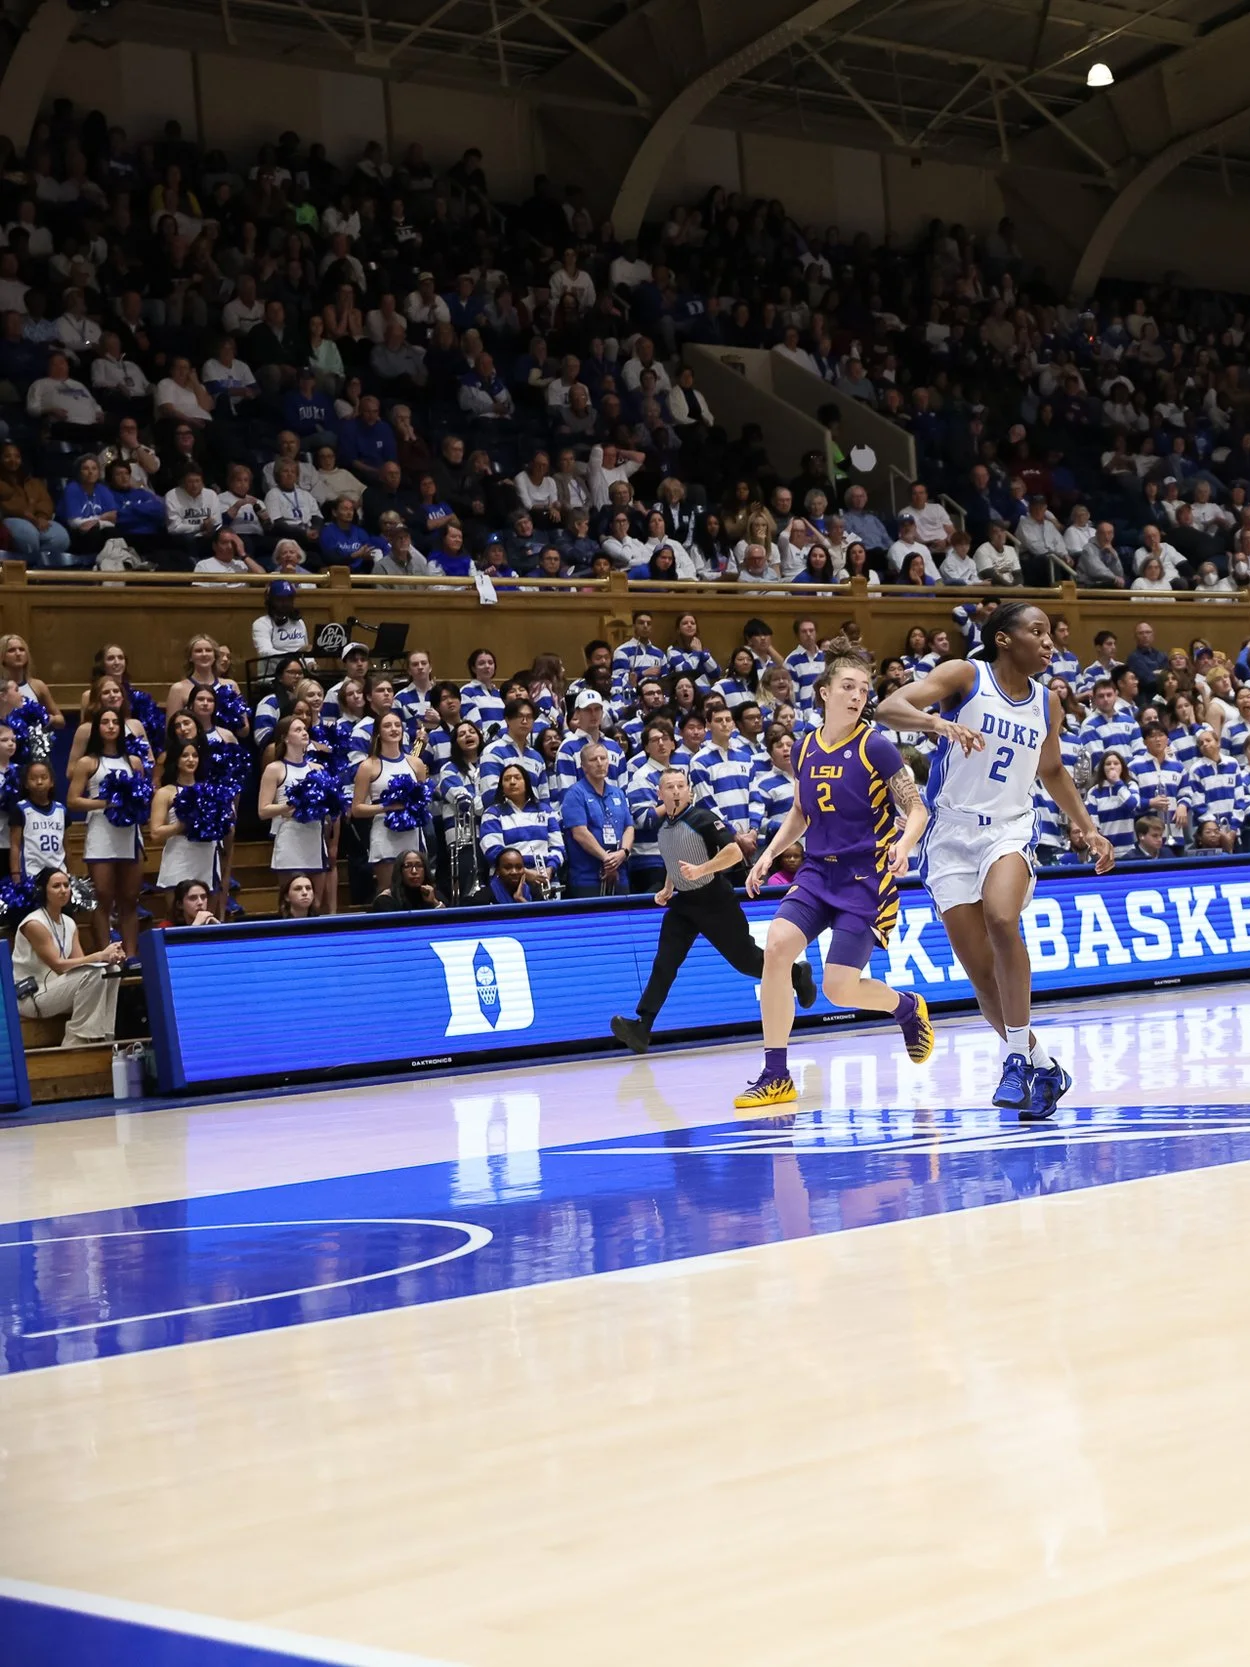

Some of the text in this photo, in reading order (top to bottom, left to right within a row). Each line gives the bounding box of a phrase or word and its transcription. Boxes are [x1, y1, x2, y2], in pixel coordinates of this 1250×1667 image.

[278, 629, 305, 641] Duke
[327, 625, 338, 636] DJ
[981, 713, 1039, 750] DUKE
[989, 746, 1015, 783] 2
[810, 766, 843, 779] LSU
[817, 782, 835, 812] 2
[32, 821, 63, 832] DUKE
[40, 835, 59, 851] 26
[823, 1013, 855, 1022] DAKTRONICS
[412, 1057, 452, 1067] DAKTRONICS
